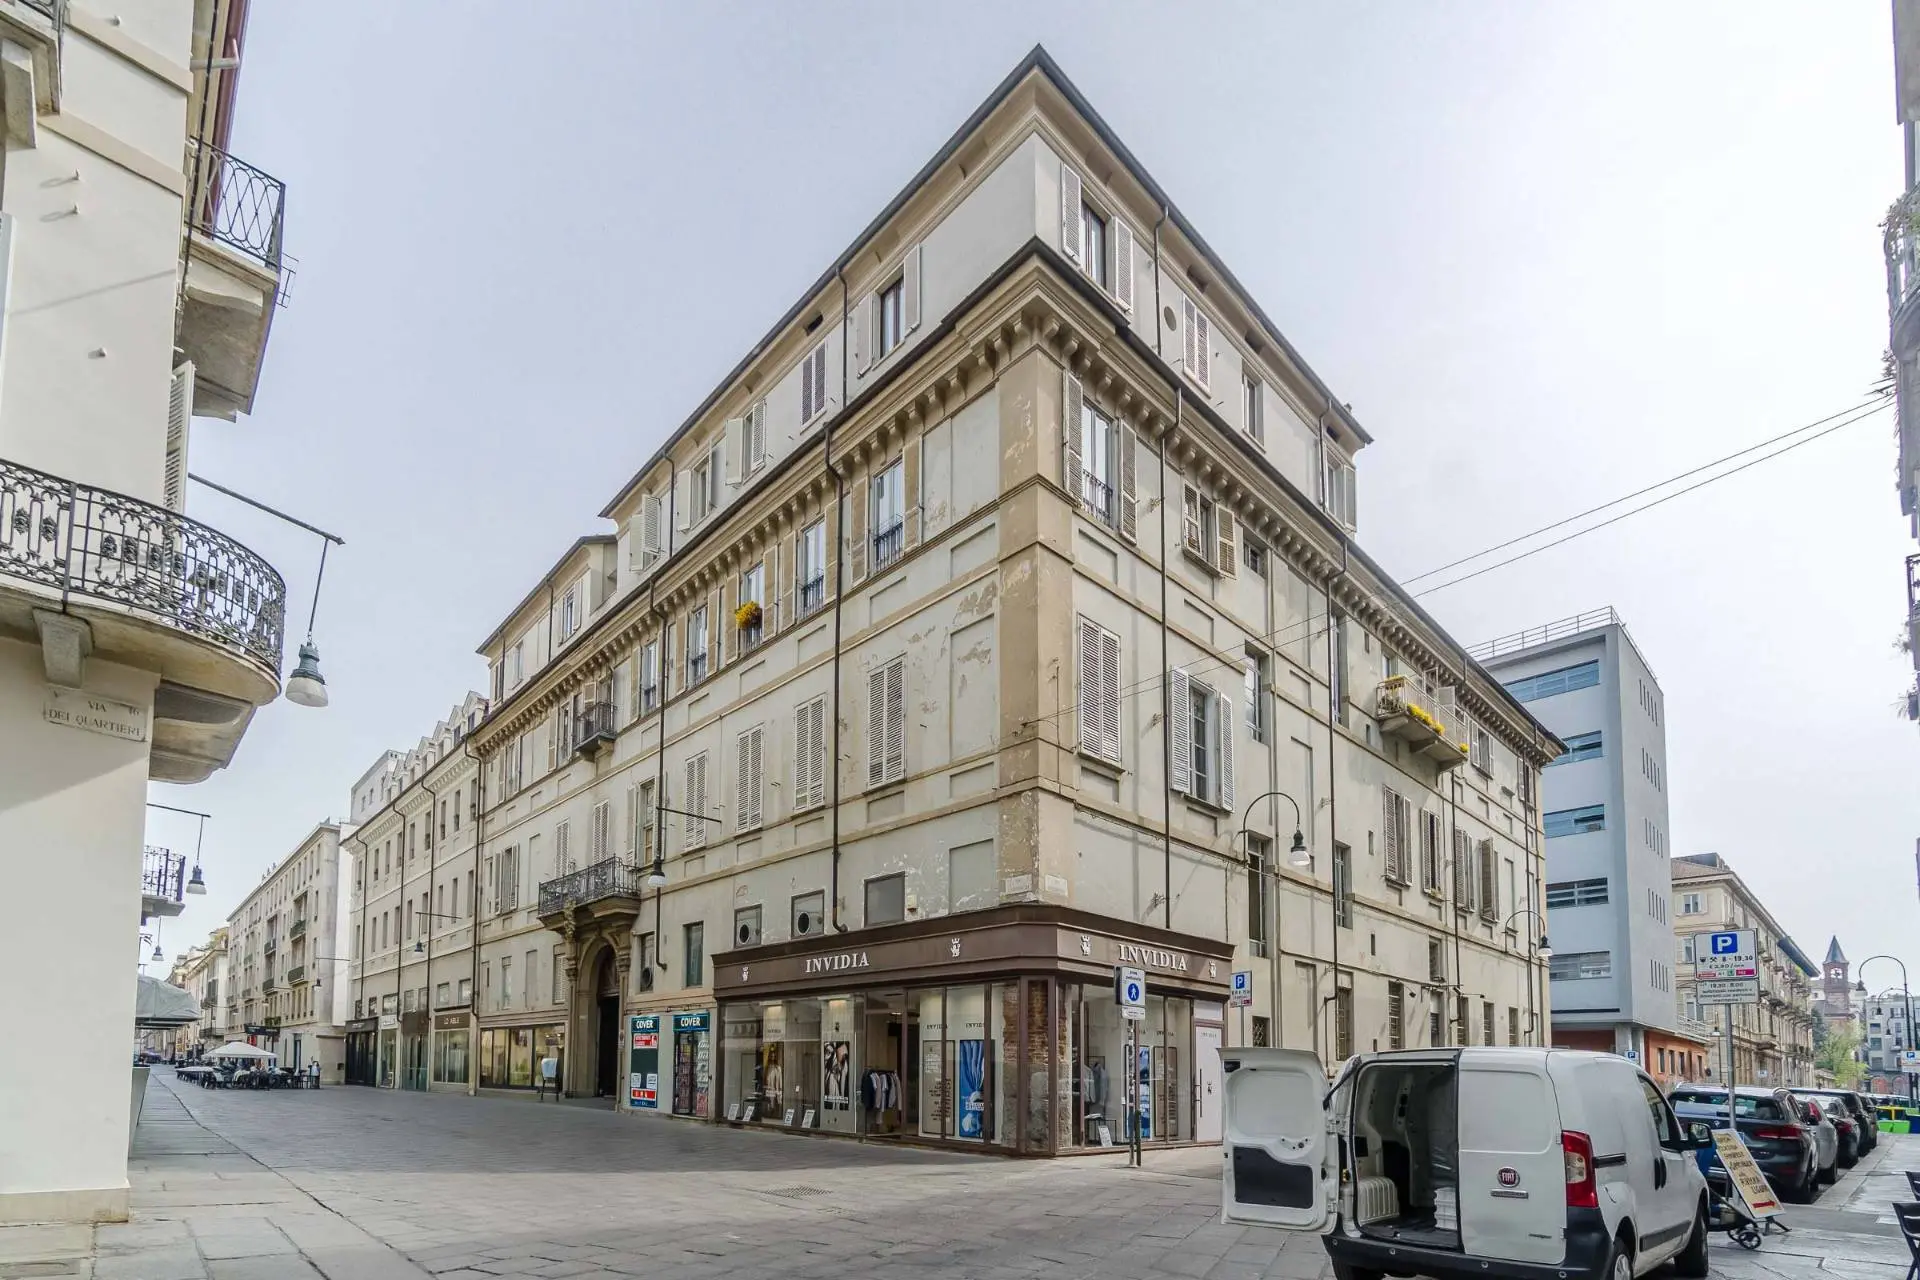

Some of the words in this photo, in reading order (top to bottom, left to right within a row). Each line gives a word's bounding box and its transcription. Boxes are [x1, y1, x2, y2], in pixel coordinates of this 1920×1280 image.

[87, 700, 107, 713] VIA
[48, 708, 70, 721] DEI
[75, 714, 140, 736] QUARTIERI
[805, 951, 870, 973] INVIDIA
[1119, 943, 1188, 972] INVIDIA
[636, 1020, 654, 1029] COVER
[680, 1017, 701, 1027] COVER
